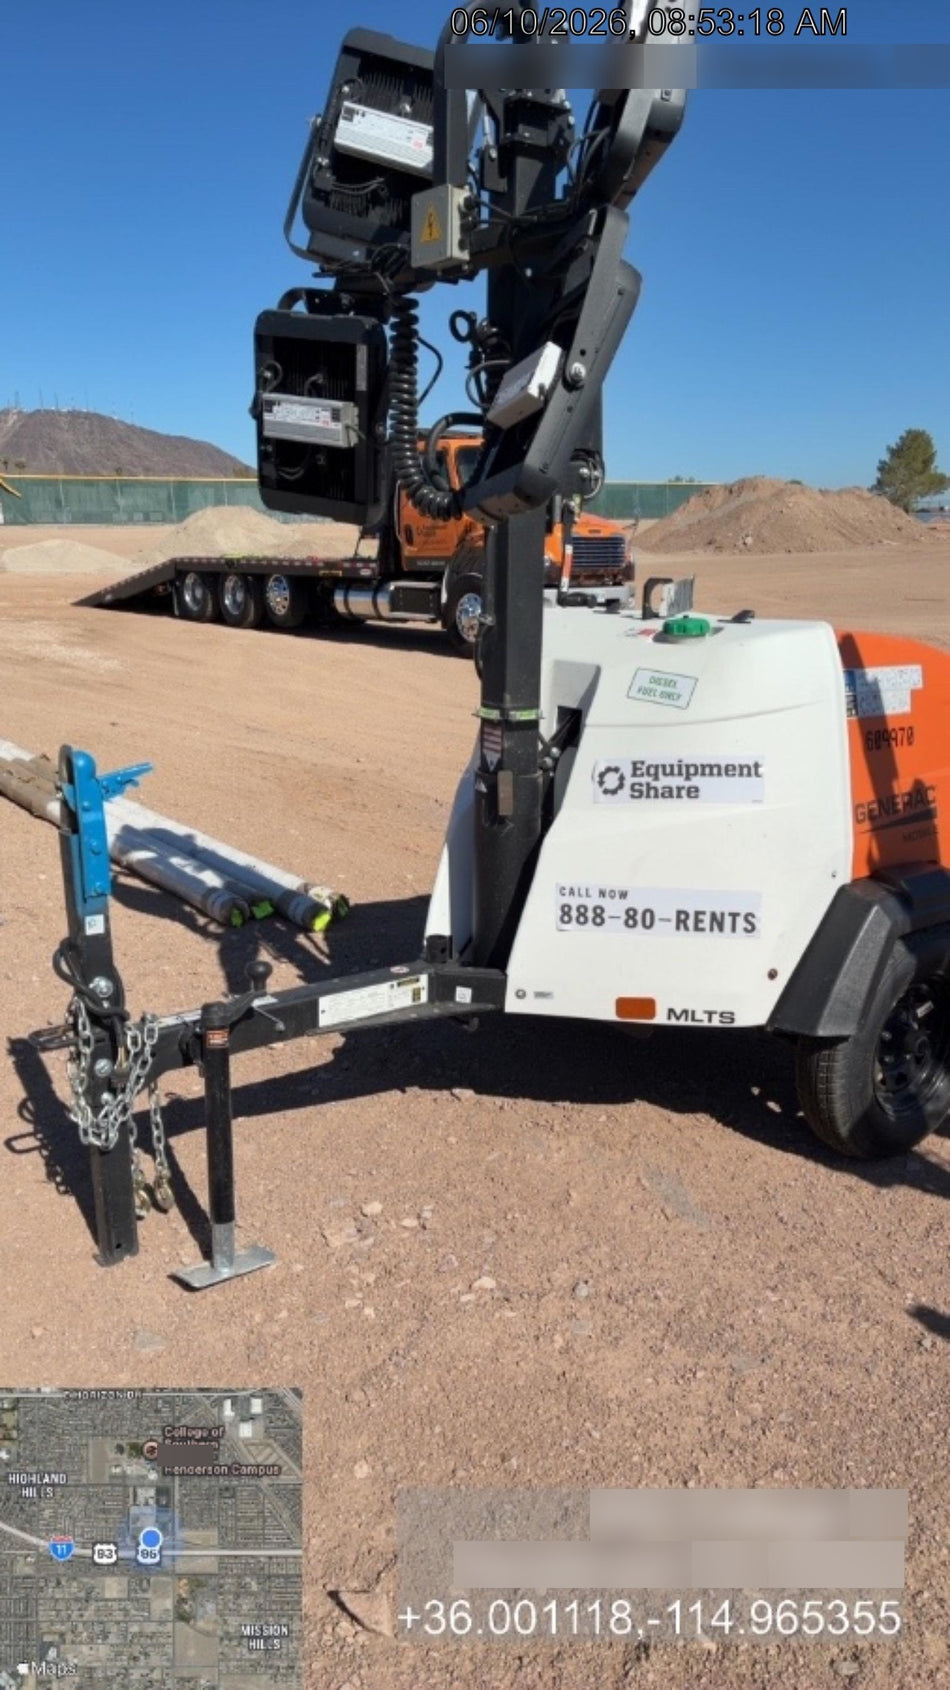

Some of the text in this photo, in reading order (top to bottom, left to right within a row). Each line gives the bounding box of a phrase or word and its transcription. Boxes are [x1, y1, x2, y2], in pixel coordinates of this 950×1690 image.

[630, 759, 763, 781] Equipment
[629, 782, 700, 799] Share
[855, 784, 937, 825] GENERAC
[559, 886, 629, 900] CALL NOW
[559, 904, 757, 934] 888-80-RENTS
[667, 1007, 735, 1025] MLTS
